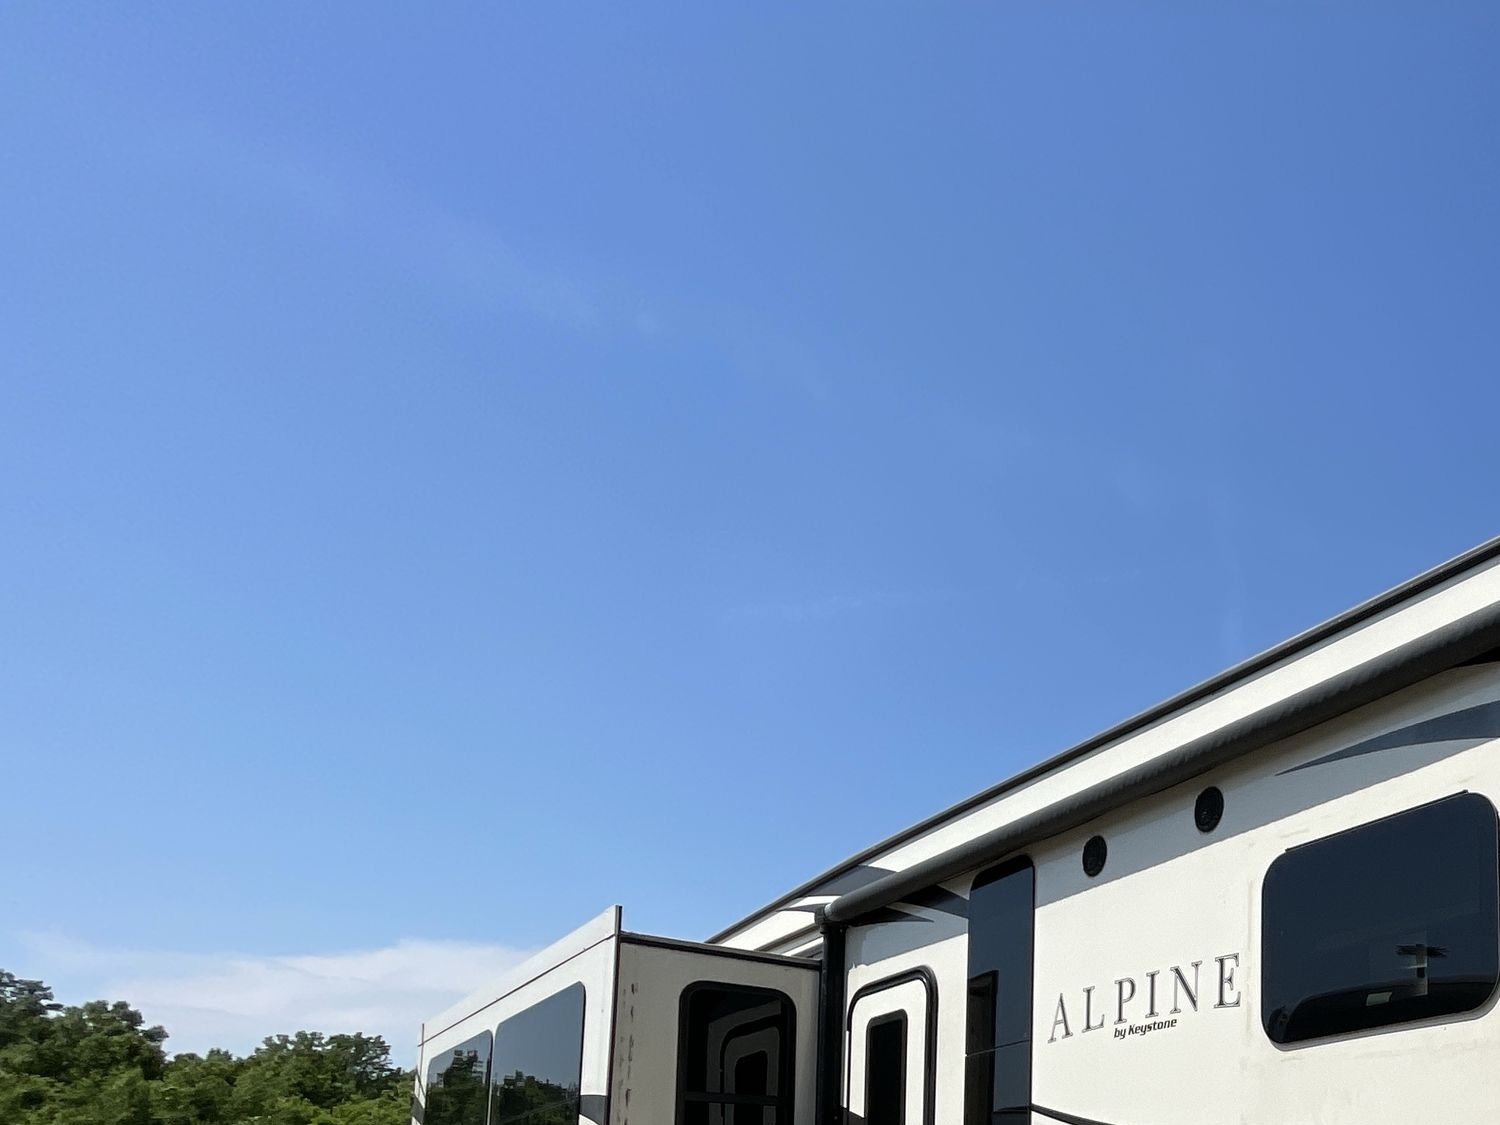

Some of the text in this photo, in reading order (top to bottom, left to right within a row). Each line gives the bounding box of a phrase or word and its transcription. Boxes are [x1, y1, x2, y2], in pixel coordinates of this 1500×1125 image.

[1047, 952, 1242, 1044] ALPINE
[1113, 1018, 1178, 1040] by Keystone
